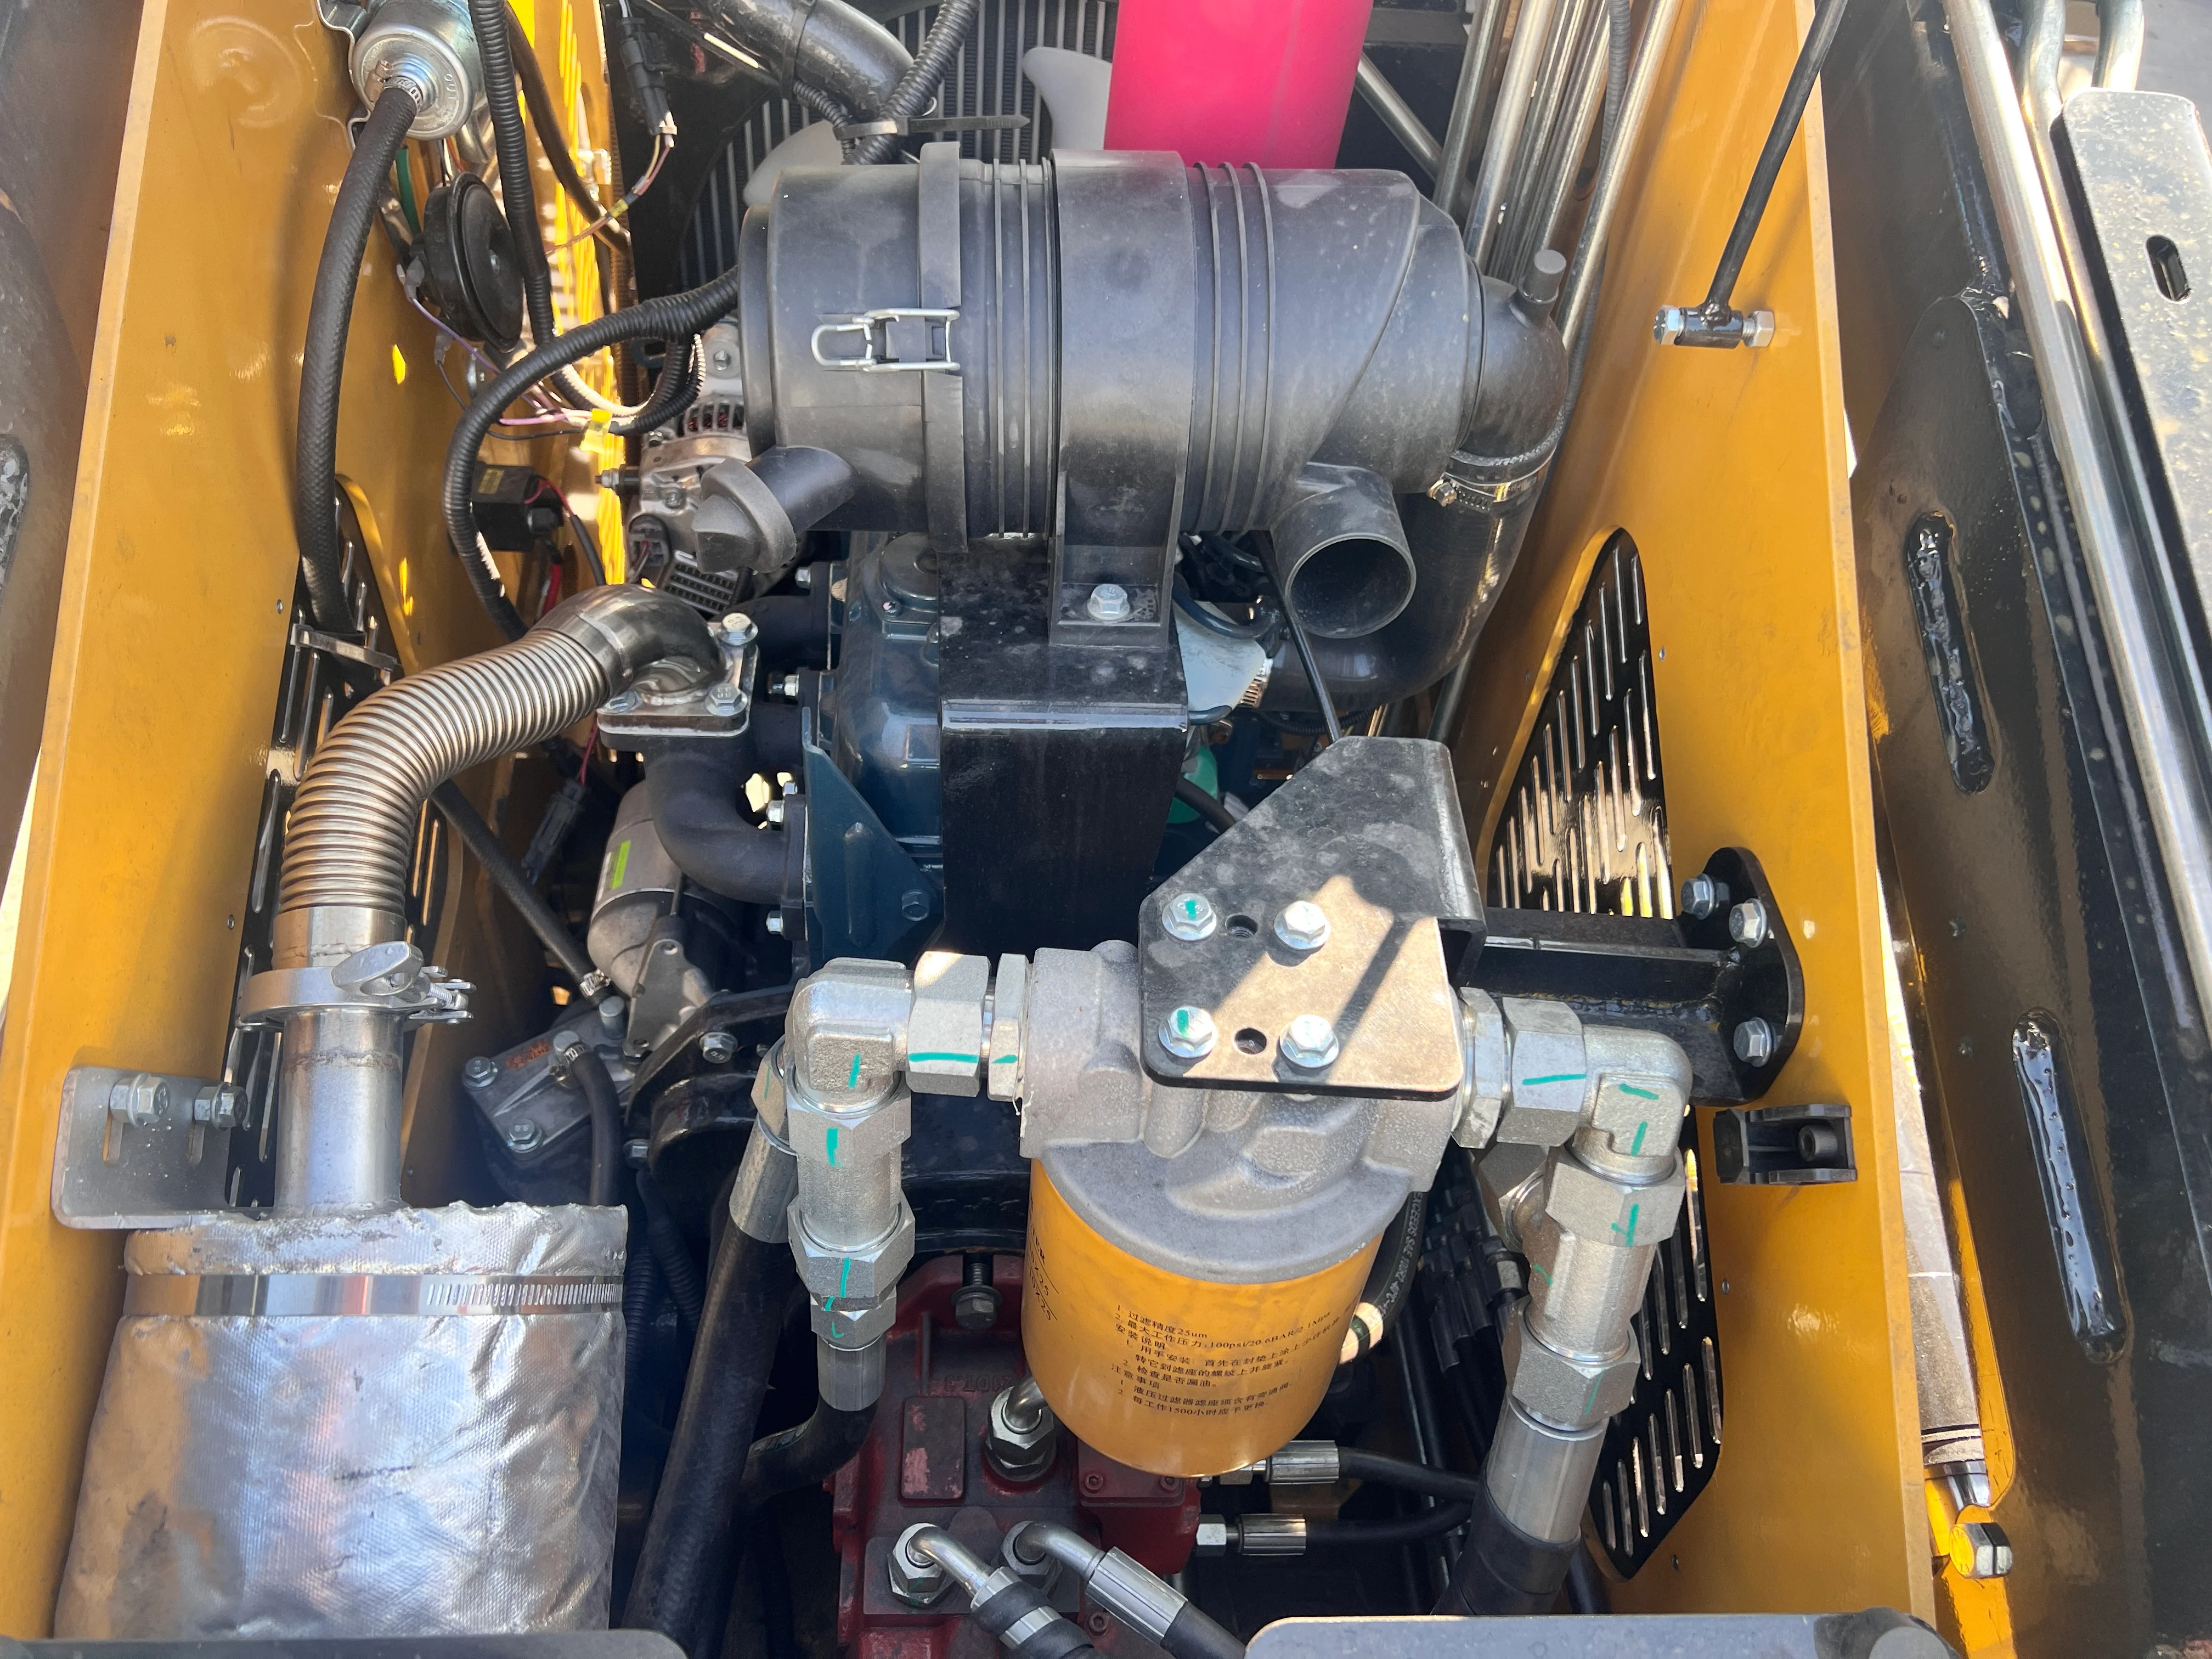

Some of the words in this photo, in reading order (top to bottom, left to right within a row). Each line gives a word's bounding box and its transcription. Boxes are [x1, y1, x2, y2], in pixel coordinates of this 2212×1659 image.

[1408, 1192, 1423, 1237] EXCEEDS
[1403, 1236, 1415, 1257] SAE
[1115, 1323, 1165, 1350] 安装说明
[1111, 1363, 1160, 1390] 注意事项
